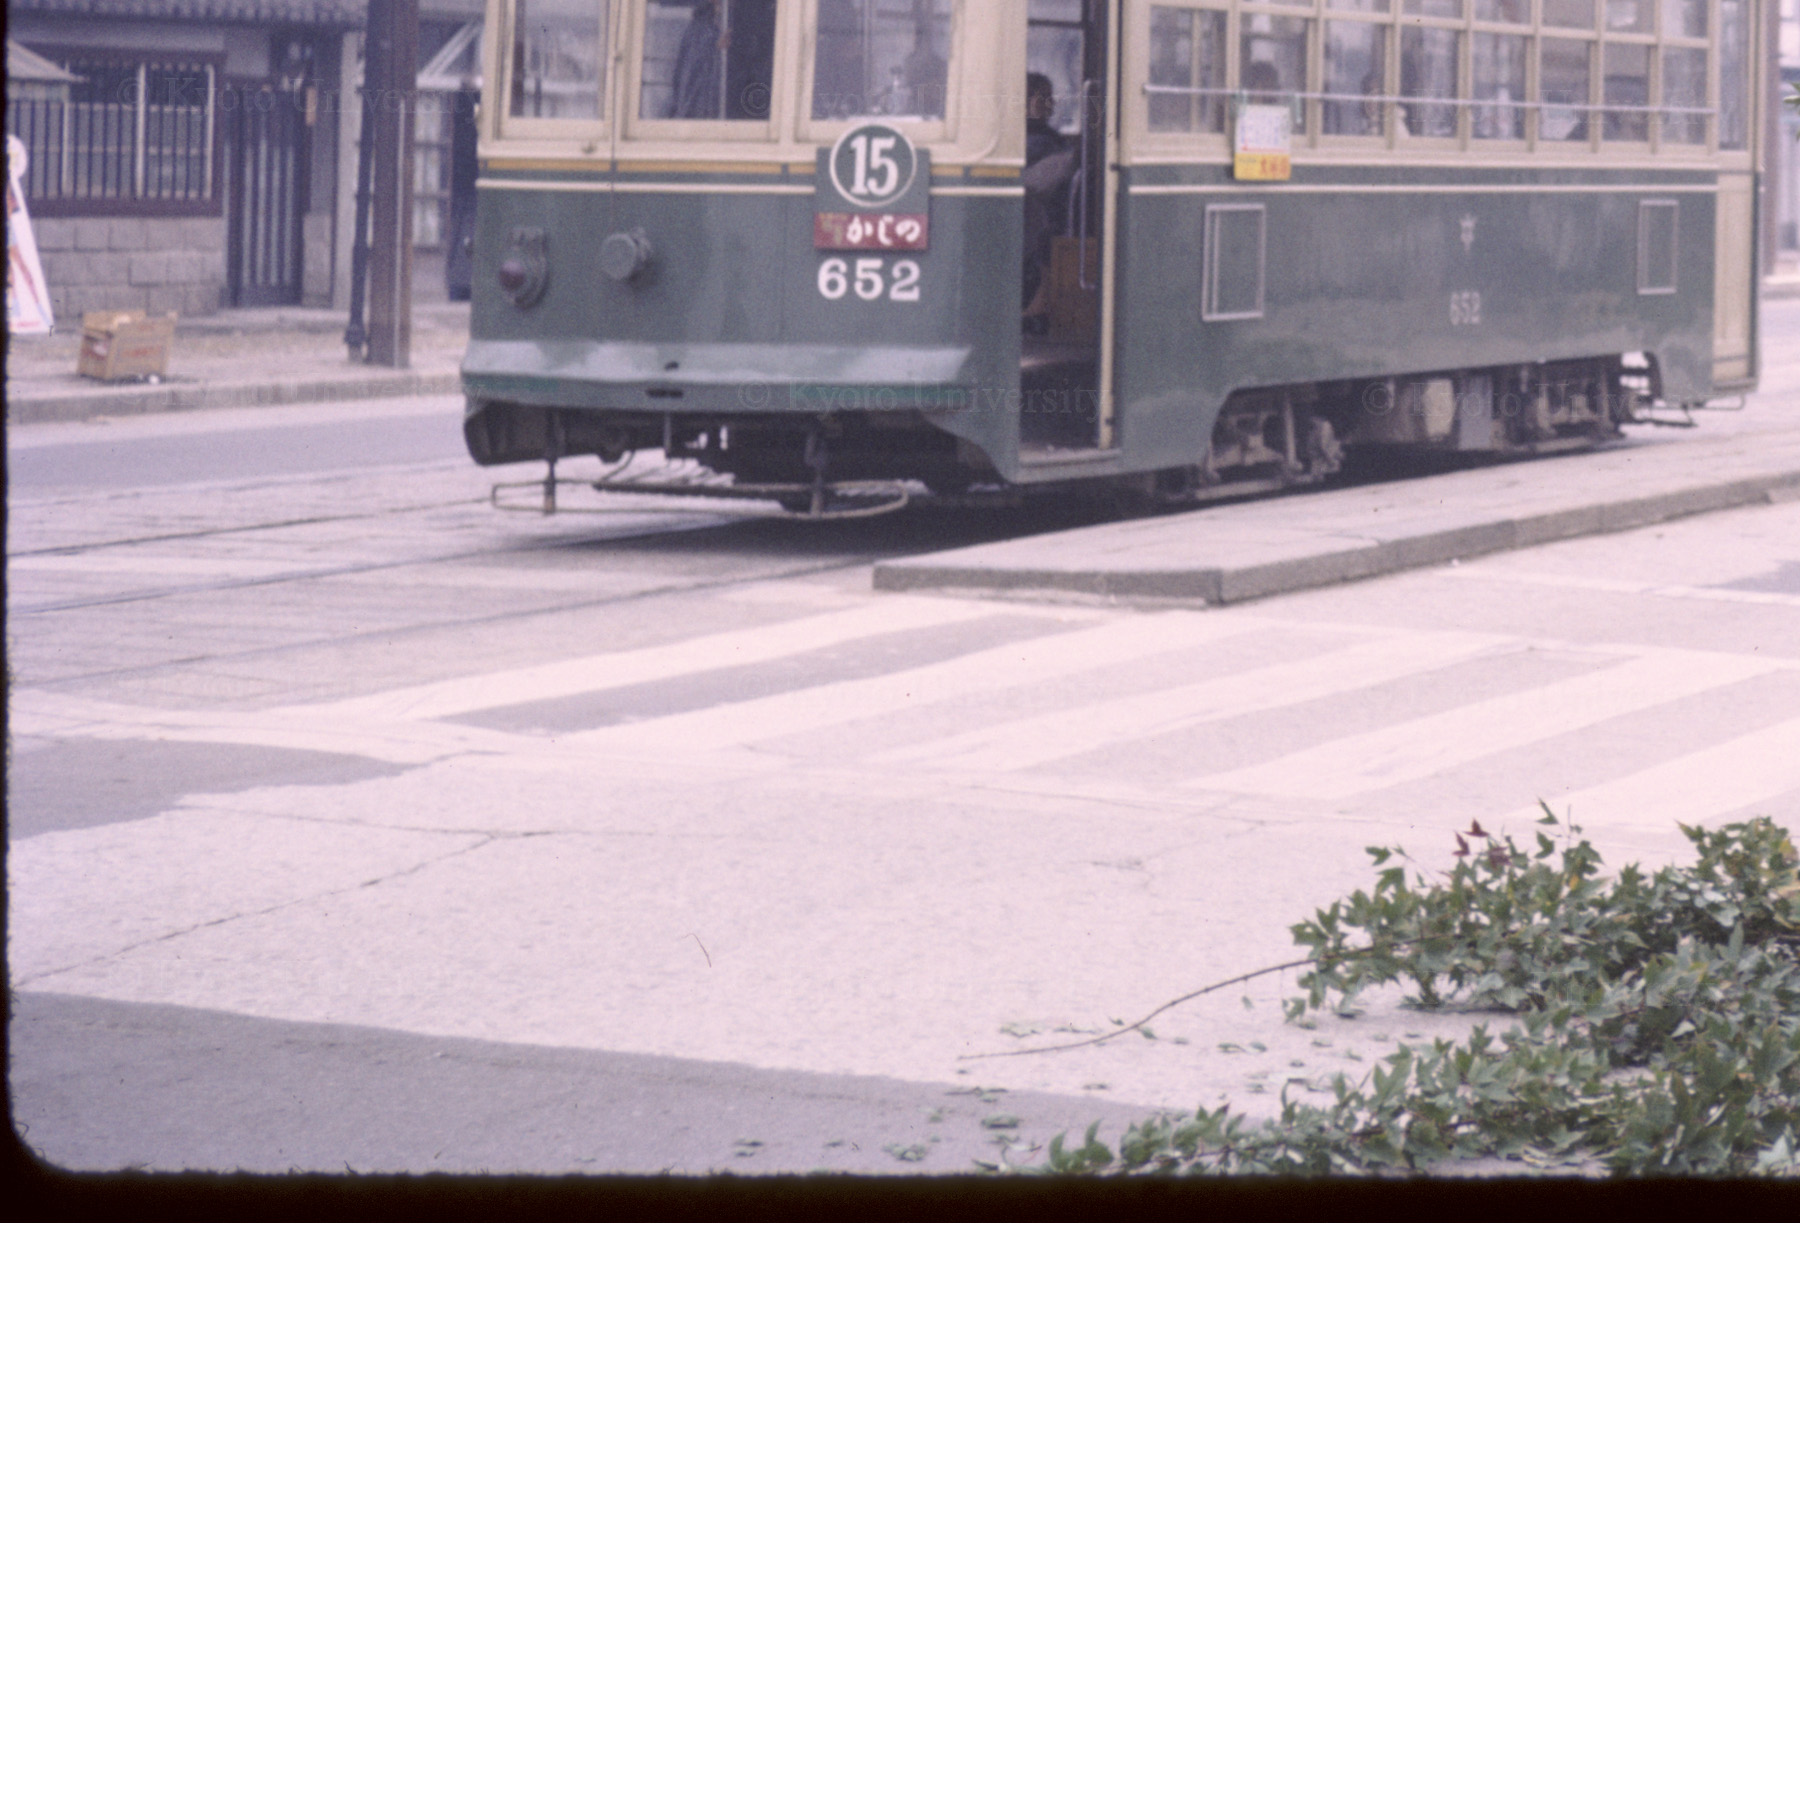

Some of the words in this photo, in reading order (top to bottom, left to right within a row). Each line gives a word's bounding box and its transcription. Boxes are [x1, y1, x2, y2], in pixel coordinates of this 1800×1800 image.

[850, 134, 899, 197] 15
[817, 257, 921, 301] 652
[1449, 291, 1481, 325] 652
